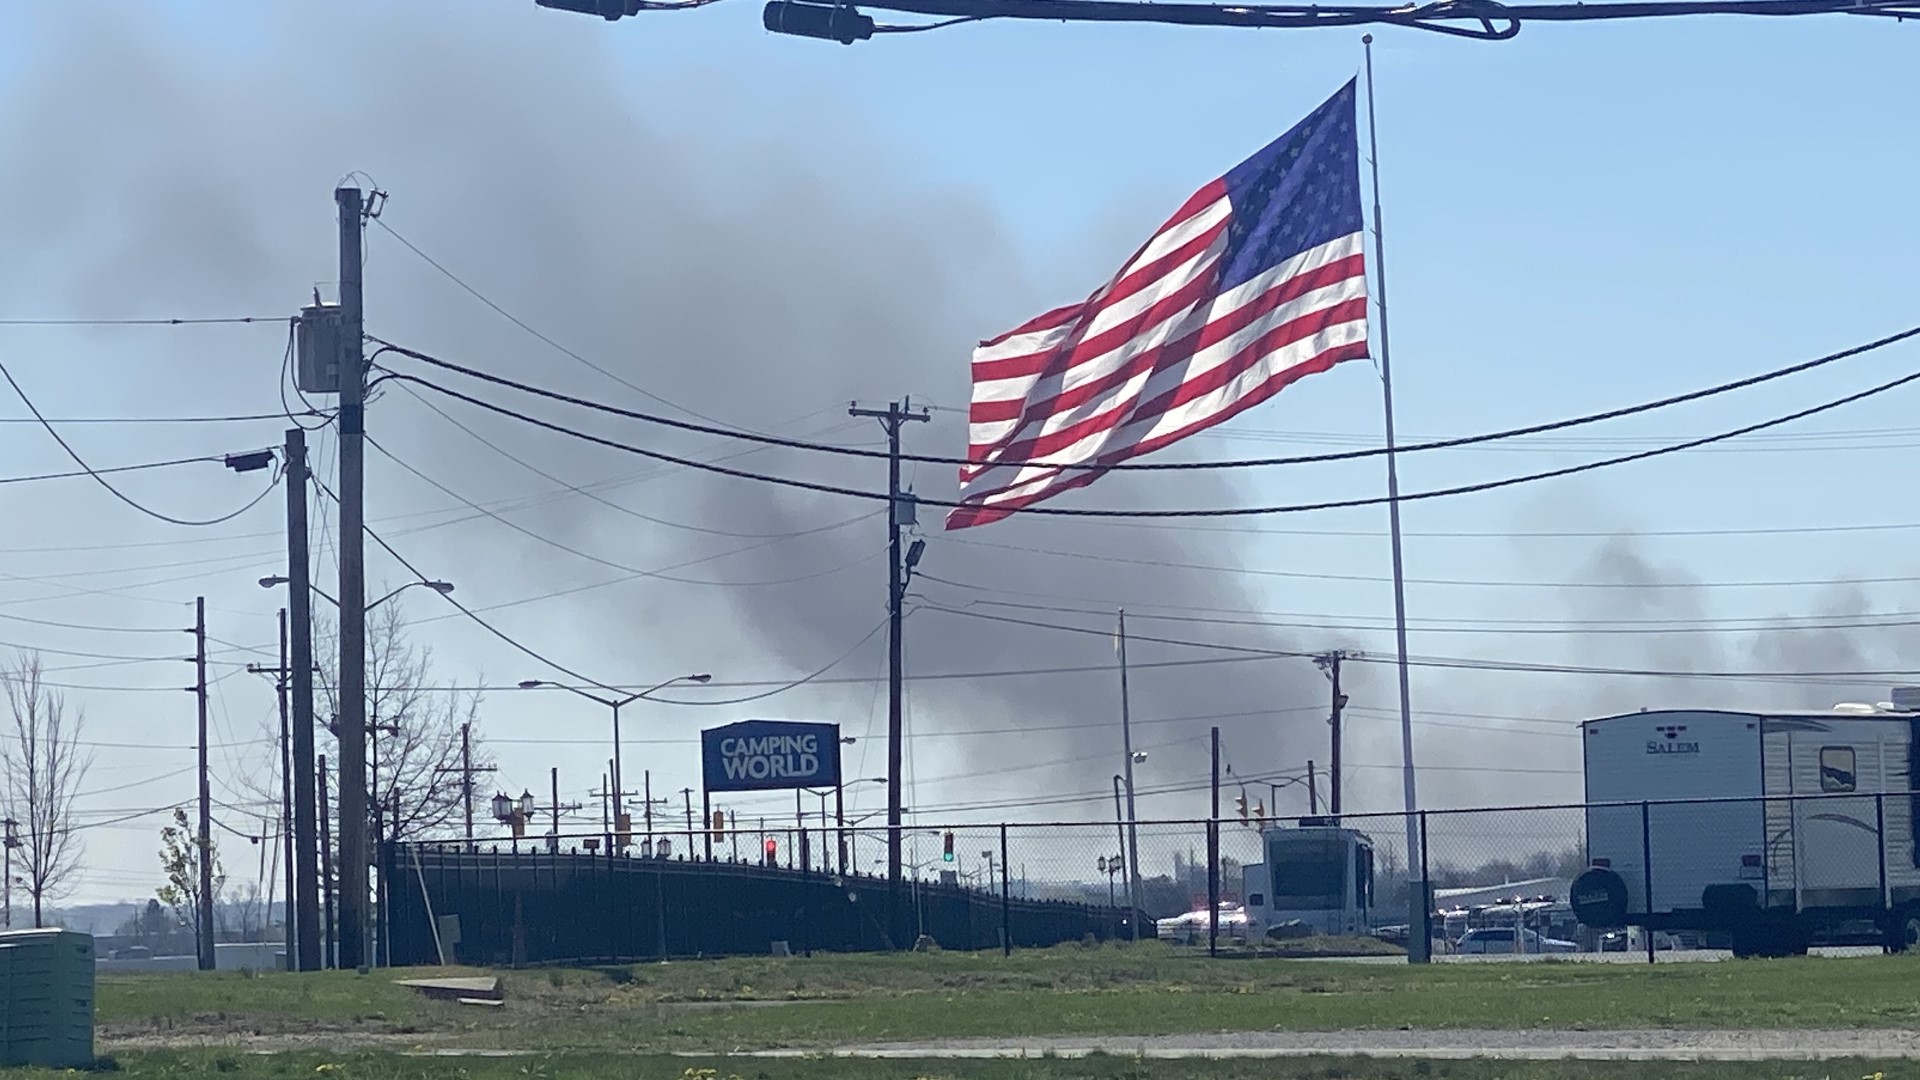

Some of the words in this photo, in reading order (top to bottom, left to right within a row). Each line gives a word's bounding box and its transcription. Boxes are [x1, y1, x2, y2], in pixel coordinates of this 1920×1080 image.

[720, 734, 818, 757] CAMPING
[1646, 741, 1700, 754] SALEM
[722, 753, 819, 780] WORLD
